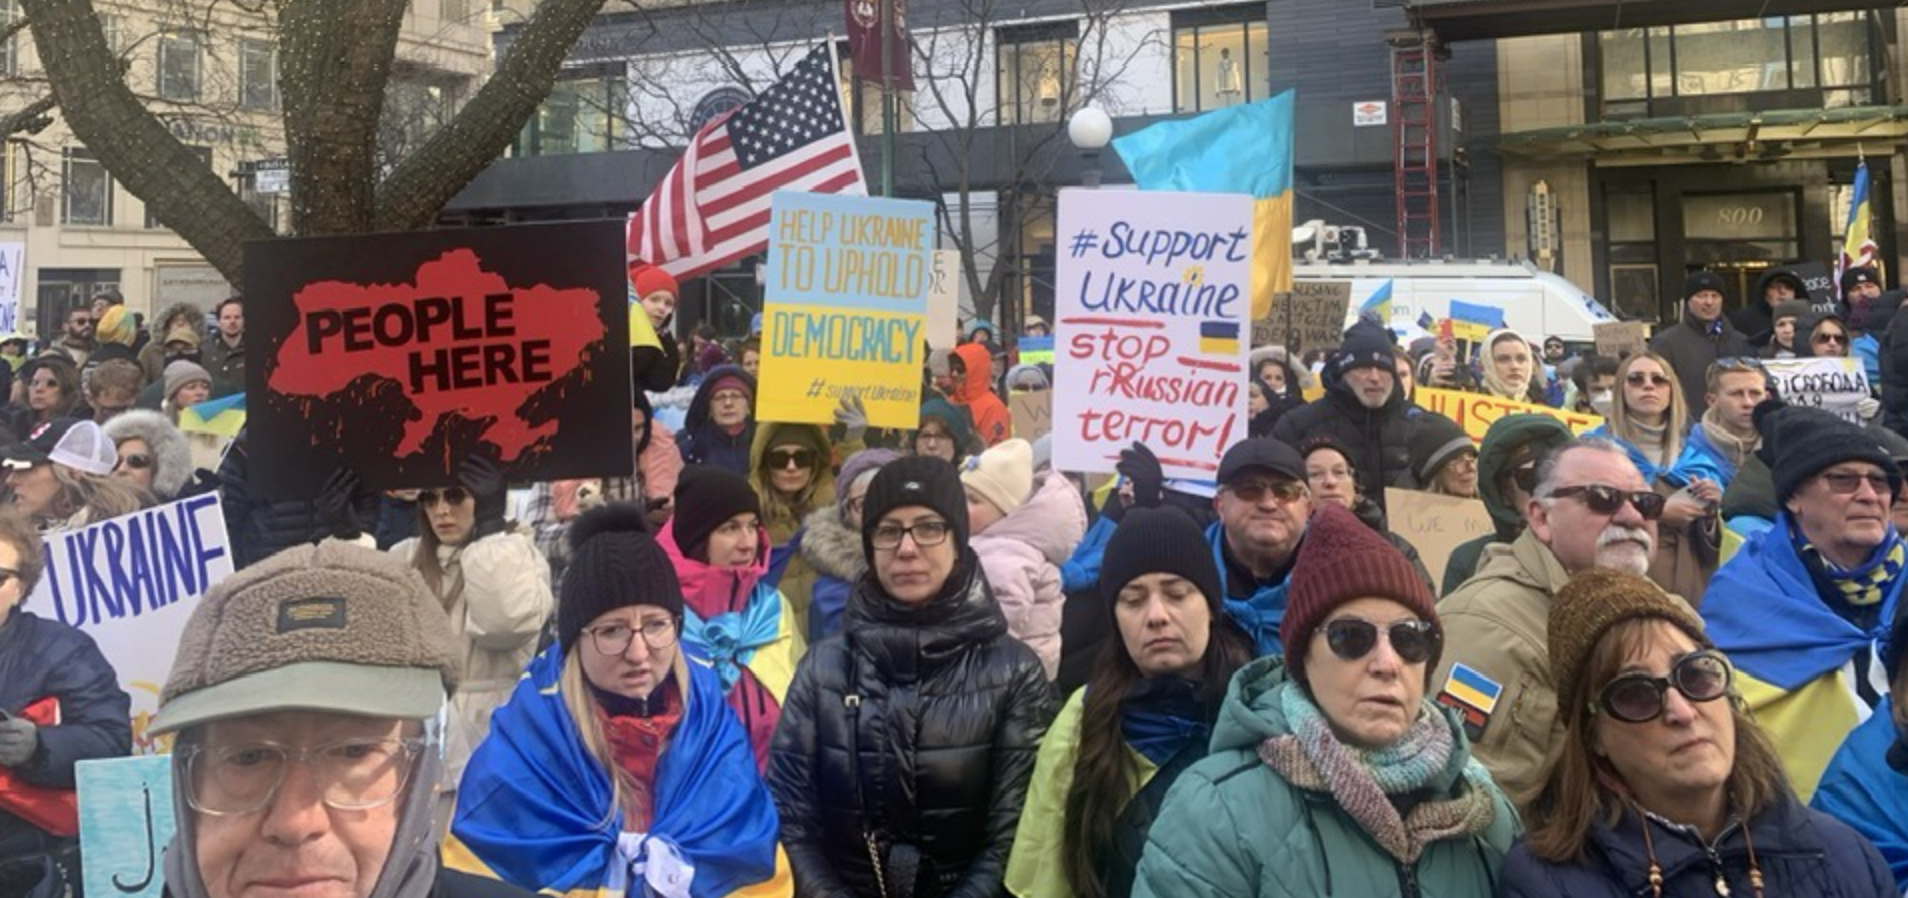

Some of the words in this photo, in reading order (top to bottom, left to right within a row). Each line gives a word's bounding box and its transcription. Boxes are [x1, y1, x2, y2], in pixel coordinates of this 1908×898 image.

[779, 208, 833, 245] HELP
[839, 213, 928, 251] UKRAINE
[1717, 206, 1764, 226] 800
[1068, 221, 1249, 267] #Support
[778, 243, 815, 292] TO
[823, 248, 923, 299] UPHOLD
[306, 293, 516, 355] PEOPLE
[771, 311, 921, 364] DEMOCRACY
[1305, 327, 1341, 343] WAR
[408, 339, 553, 395] HERE
